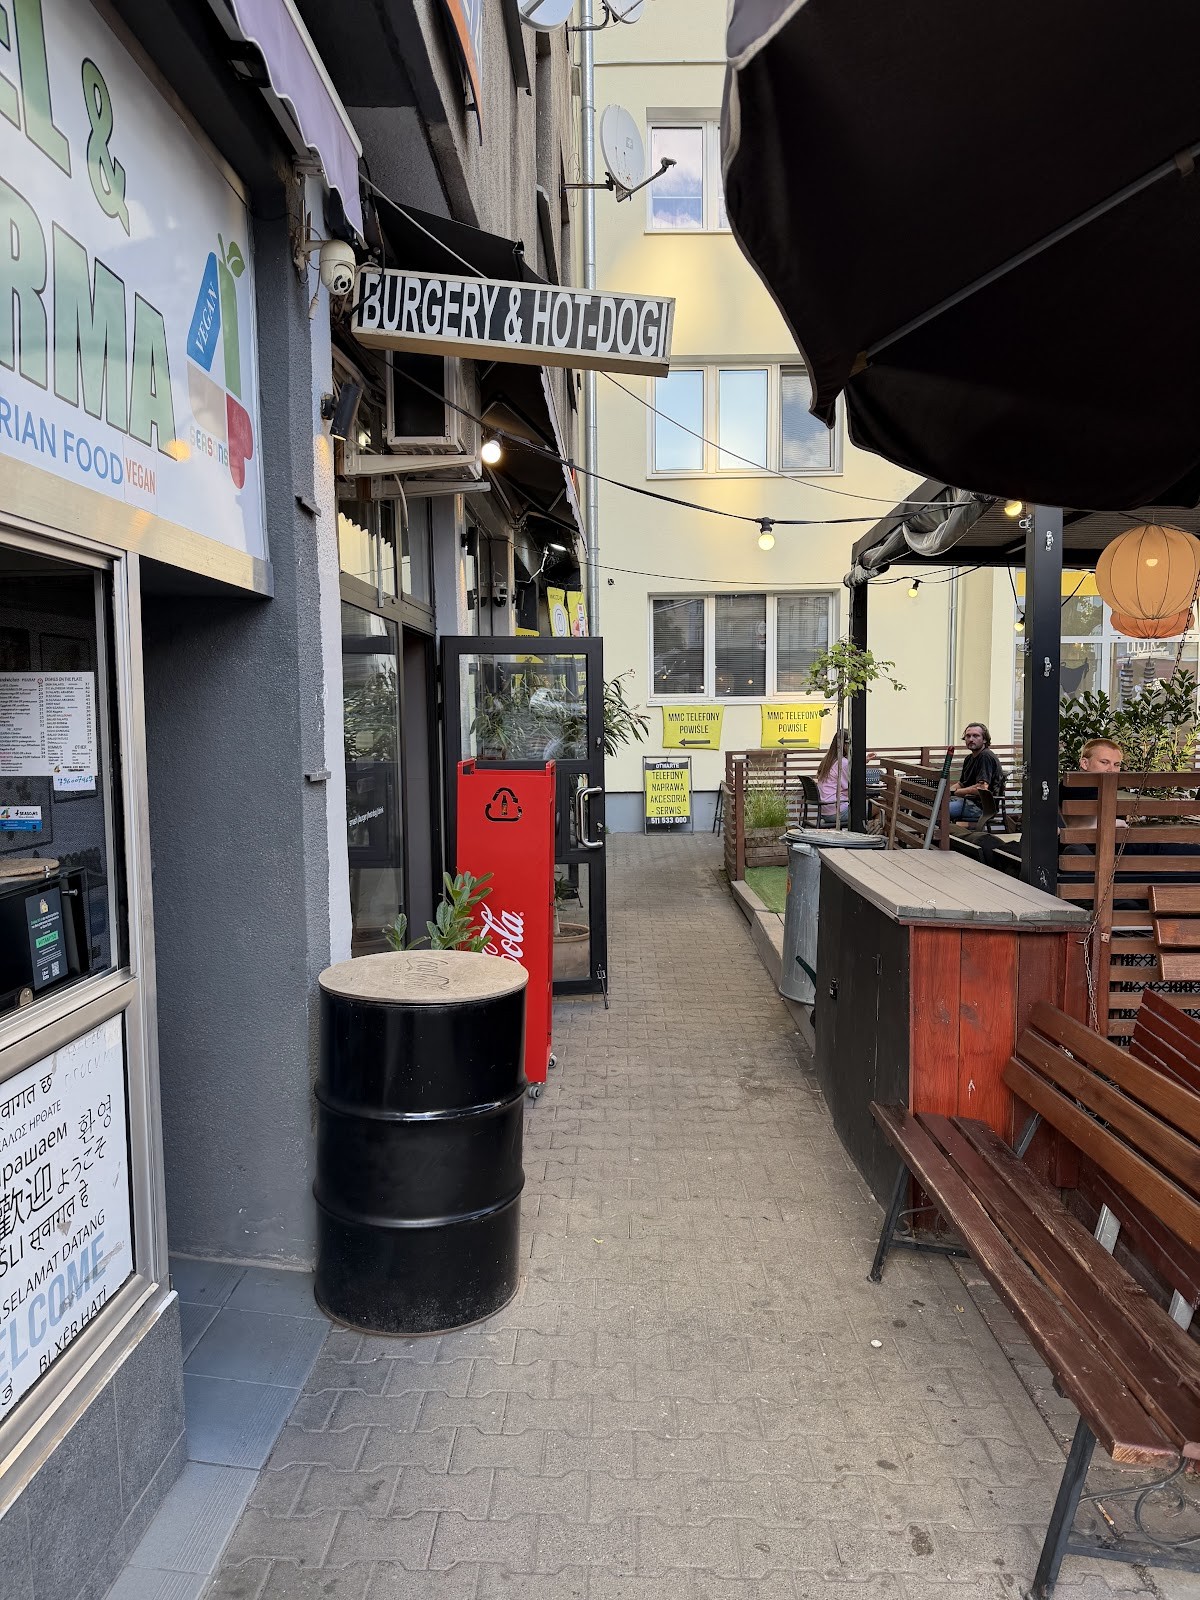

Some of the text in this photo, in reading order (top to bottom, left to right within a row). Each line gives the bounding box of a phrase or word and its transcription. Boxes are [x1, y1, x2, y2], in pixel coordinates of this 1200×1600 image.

[82, 57, 130, 237] &
[195, 281, 218, 354] VEGAN
[361, 273, 667, 358] BURGERY & HOT-DOGI
[64, 428, 124, 485] FOOD
[125, 456, 156, 496] VEGAN
[668, 712, 720, 721] MMC TELEFONY
[767, 711, 819, 720] MMC TELEFONY
[679, 724, 709, 734] POWIŚLE
[651, 783, 685, 792] NAPRAWA
[652, 771, 684, 780] TELEFONY
[650, 794, 687, 803] AKCESORIA
[656, 806, 682, 815] SERWIS
[0, 1122, 68, 1190] рашаем
[3, 1209, 105, 1320] SELAMAT DATANG
